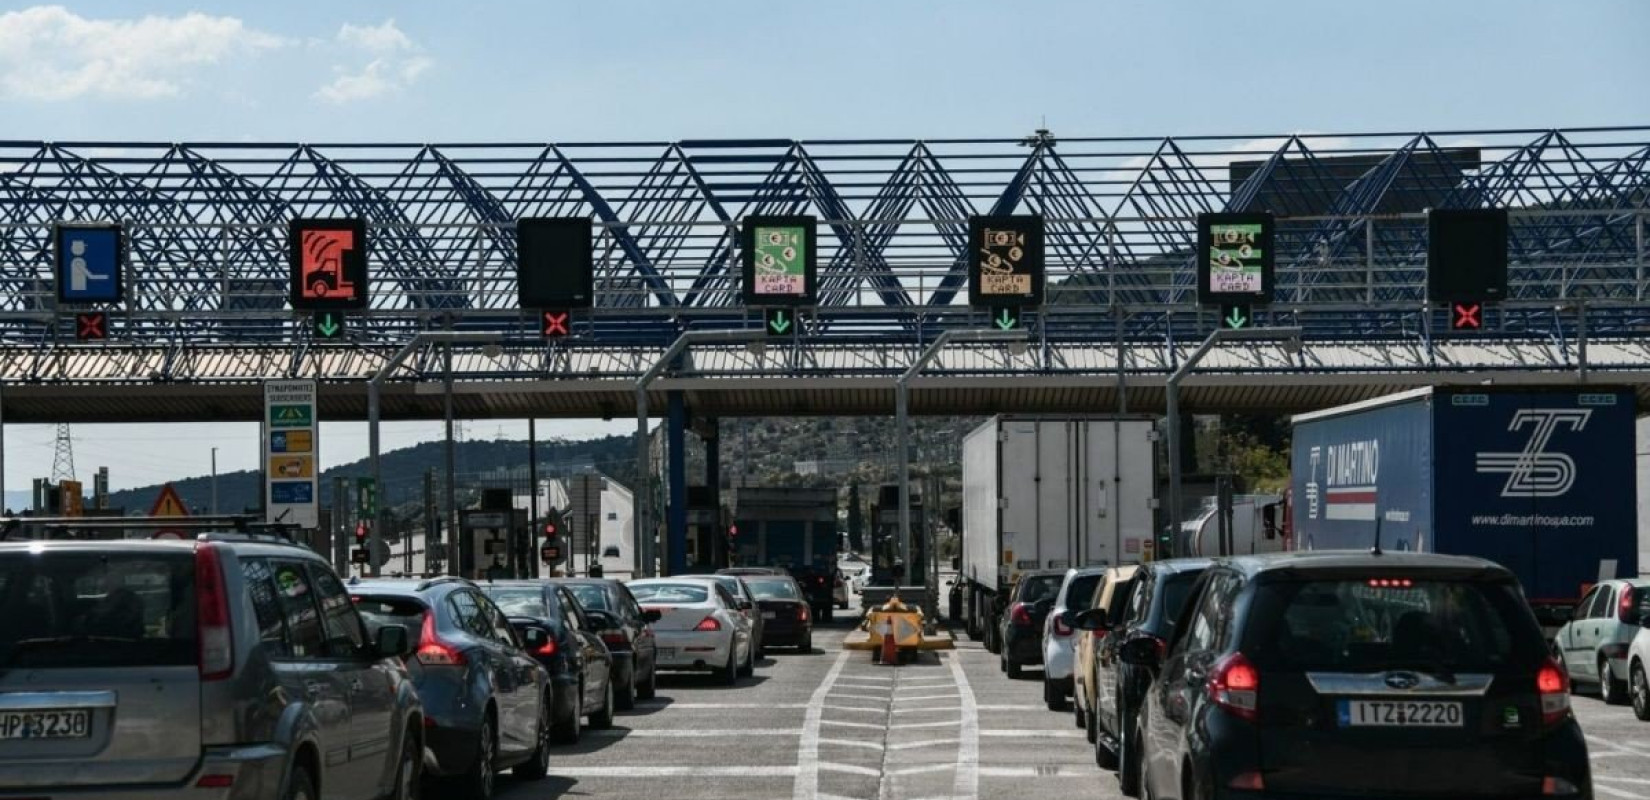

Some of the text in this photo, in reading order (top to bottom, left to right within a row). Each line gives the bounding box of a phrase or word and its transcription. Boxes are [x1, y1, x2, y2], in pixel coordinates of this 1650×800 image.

[765, 284, 793, 292] CARD
[1220, 282, 1249, 291] CARD
[1337, 438, 1379, 485] MARTINO
[1471, 513, 1594, 528] www.dimartinospa.com
[1407, 703, 1460, 724] 2220
